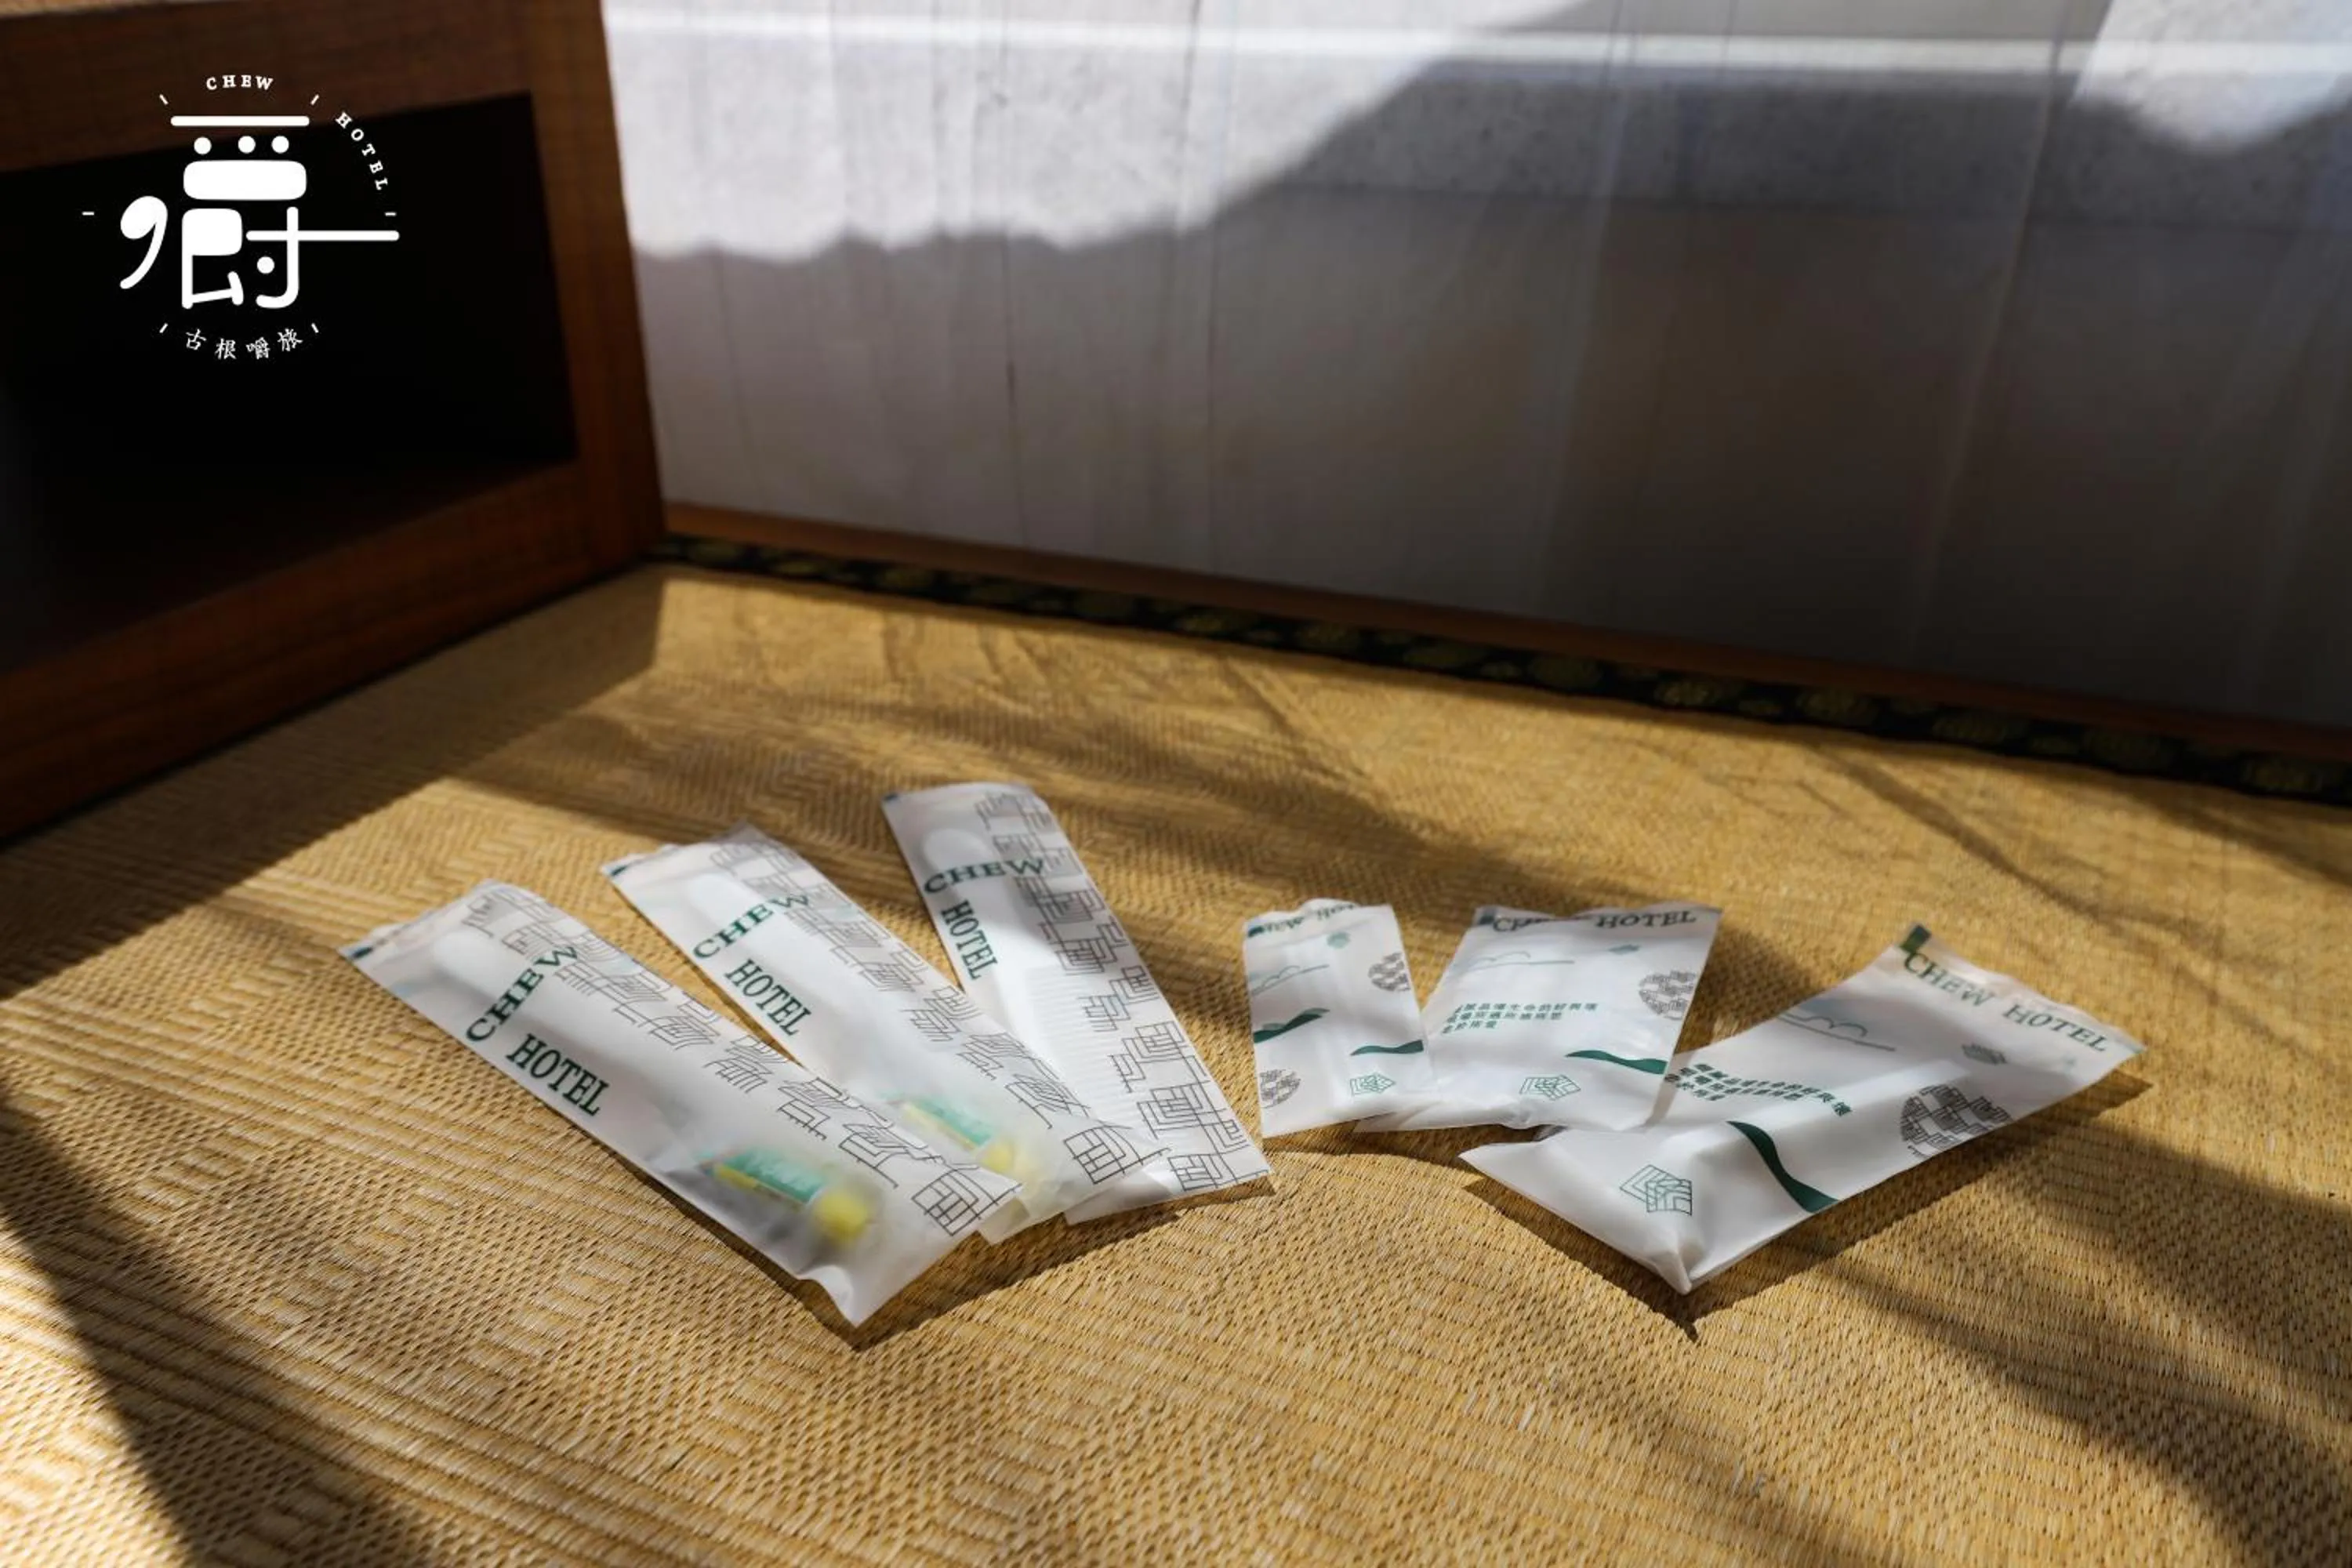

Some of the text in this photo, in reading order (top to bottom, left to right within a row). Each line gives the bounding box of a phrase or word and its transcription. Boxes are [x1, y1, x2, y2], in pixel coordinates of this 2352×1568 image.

[923, 858, 1046, 895] CHEW
[692, 891, 811, 960] CHEW
[941, 898, 999, 981] HOTEL
[1595, 909, 1697, 929] HOTEL
[465, 943, 579, 1042] CHEW
[724, 958, 812, 1036] HOTEL
[1904, 949, 2110, 1054] CHEW HOTEL
[506, 1033, 610, 1116] HOTEL
